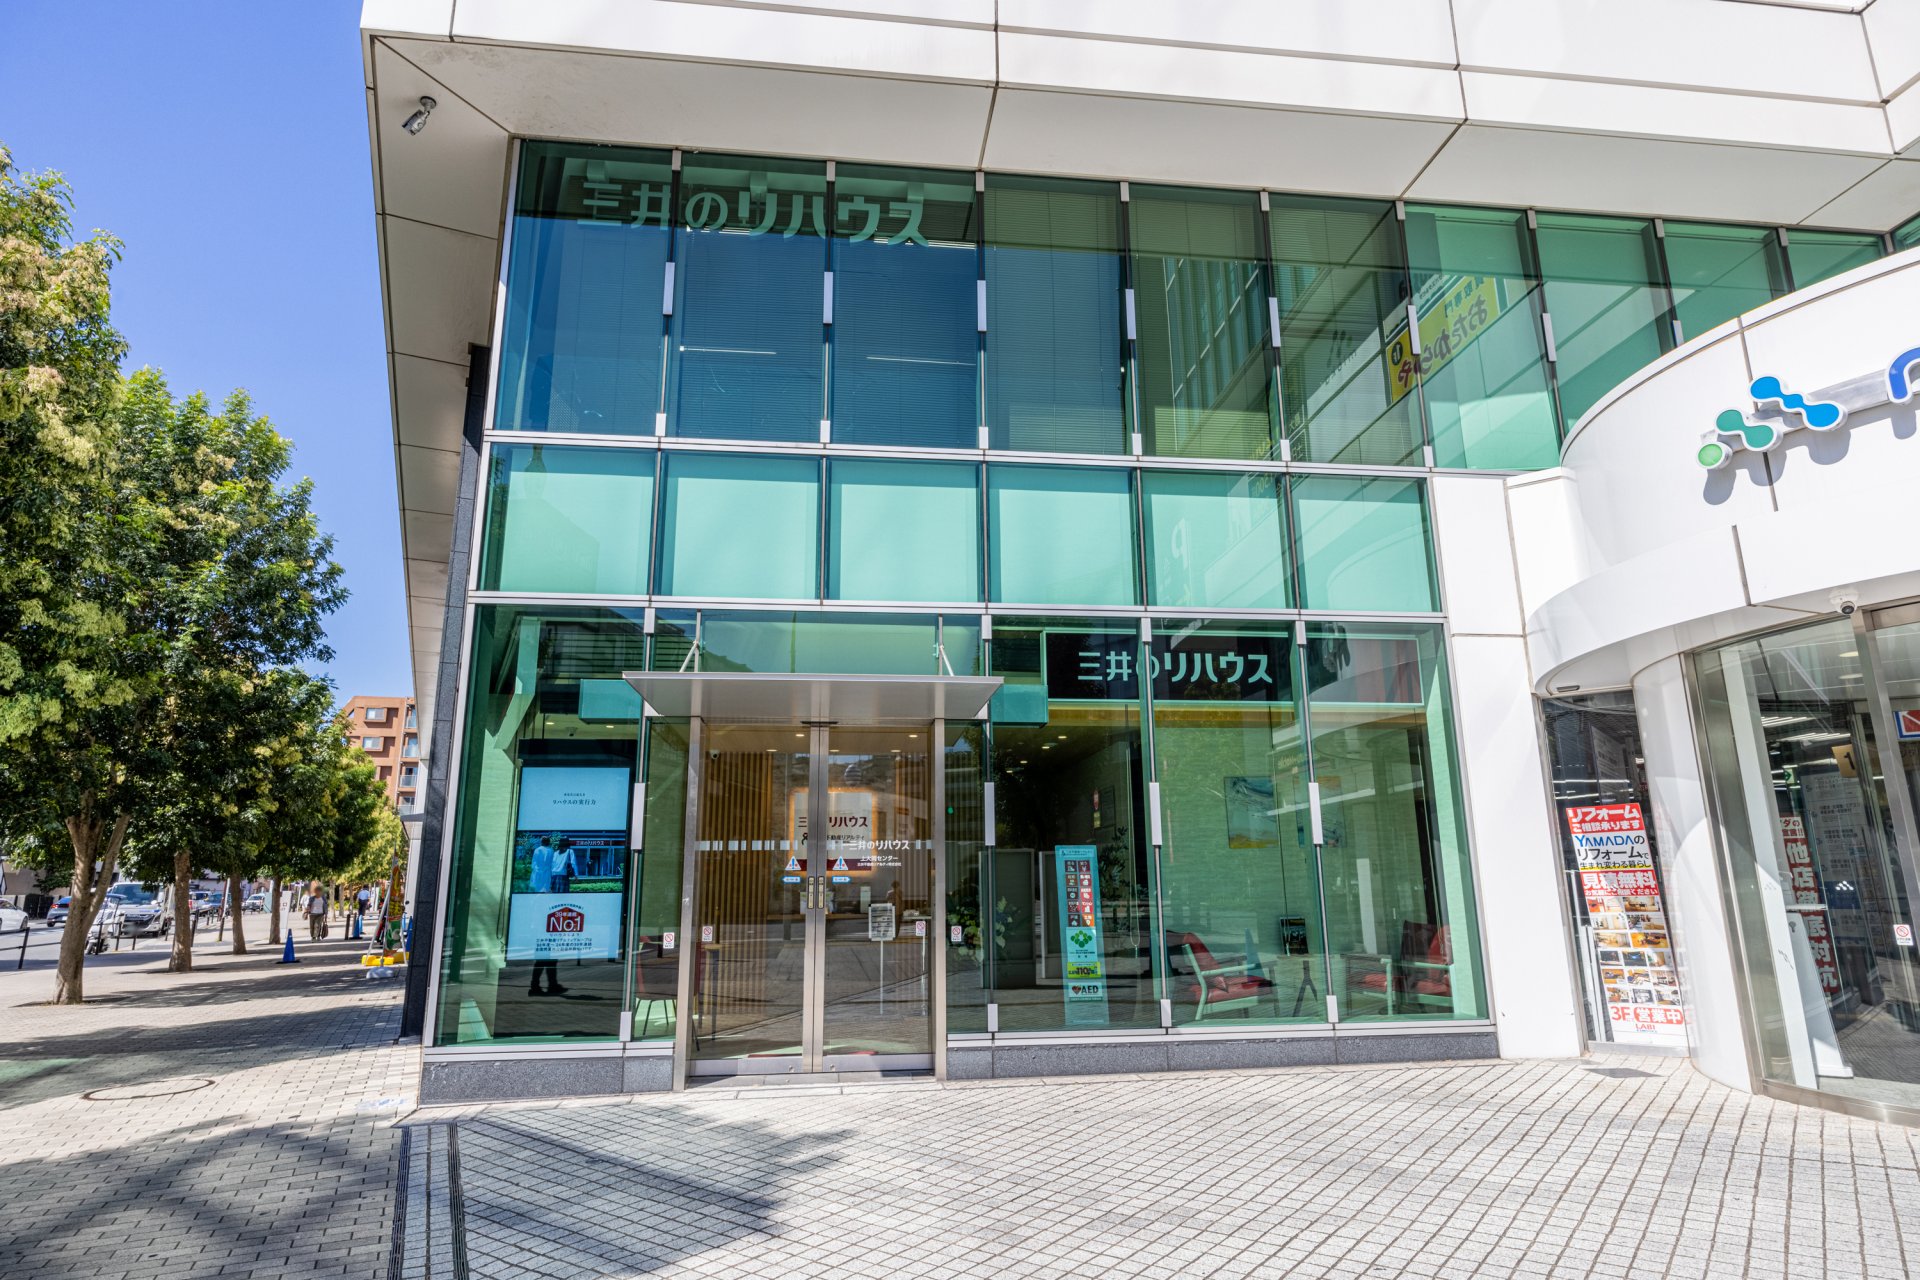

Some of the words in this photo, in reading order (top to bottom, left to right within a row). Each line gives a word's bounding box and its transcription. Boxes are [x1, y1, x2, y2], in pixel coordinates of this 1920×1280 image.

[577, 181, 929, 247] 三井のリハウス
[1567, 805, 1641, 822] リフォーム
[1572, 819, 1640, 833] ご相談承ります
[849, 839, 910, 850] 三井のリハウス
[1580, 860, 1652, 870] 生まれ変わる暮らし
[1583, 871, 1656, 890] 見積無料
[550, 916, 581, 932] No.1
[1081, 985, 1098, 994] AED
[1637, 1007, 1681, 1024] 営業中
